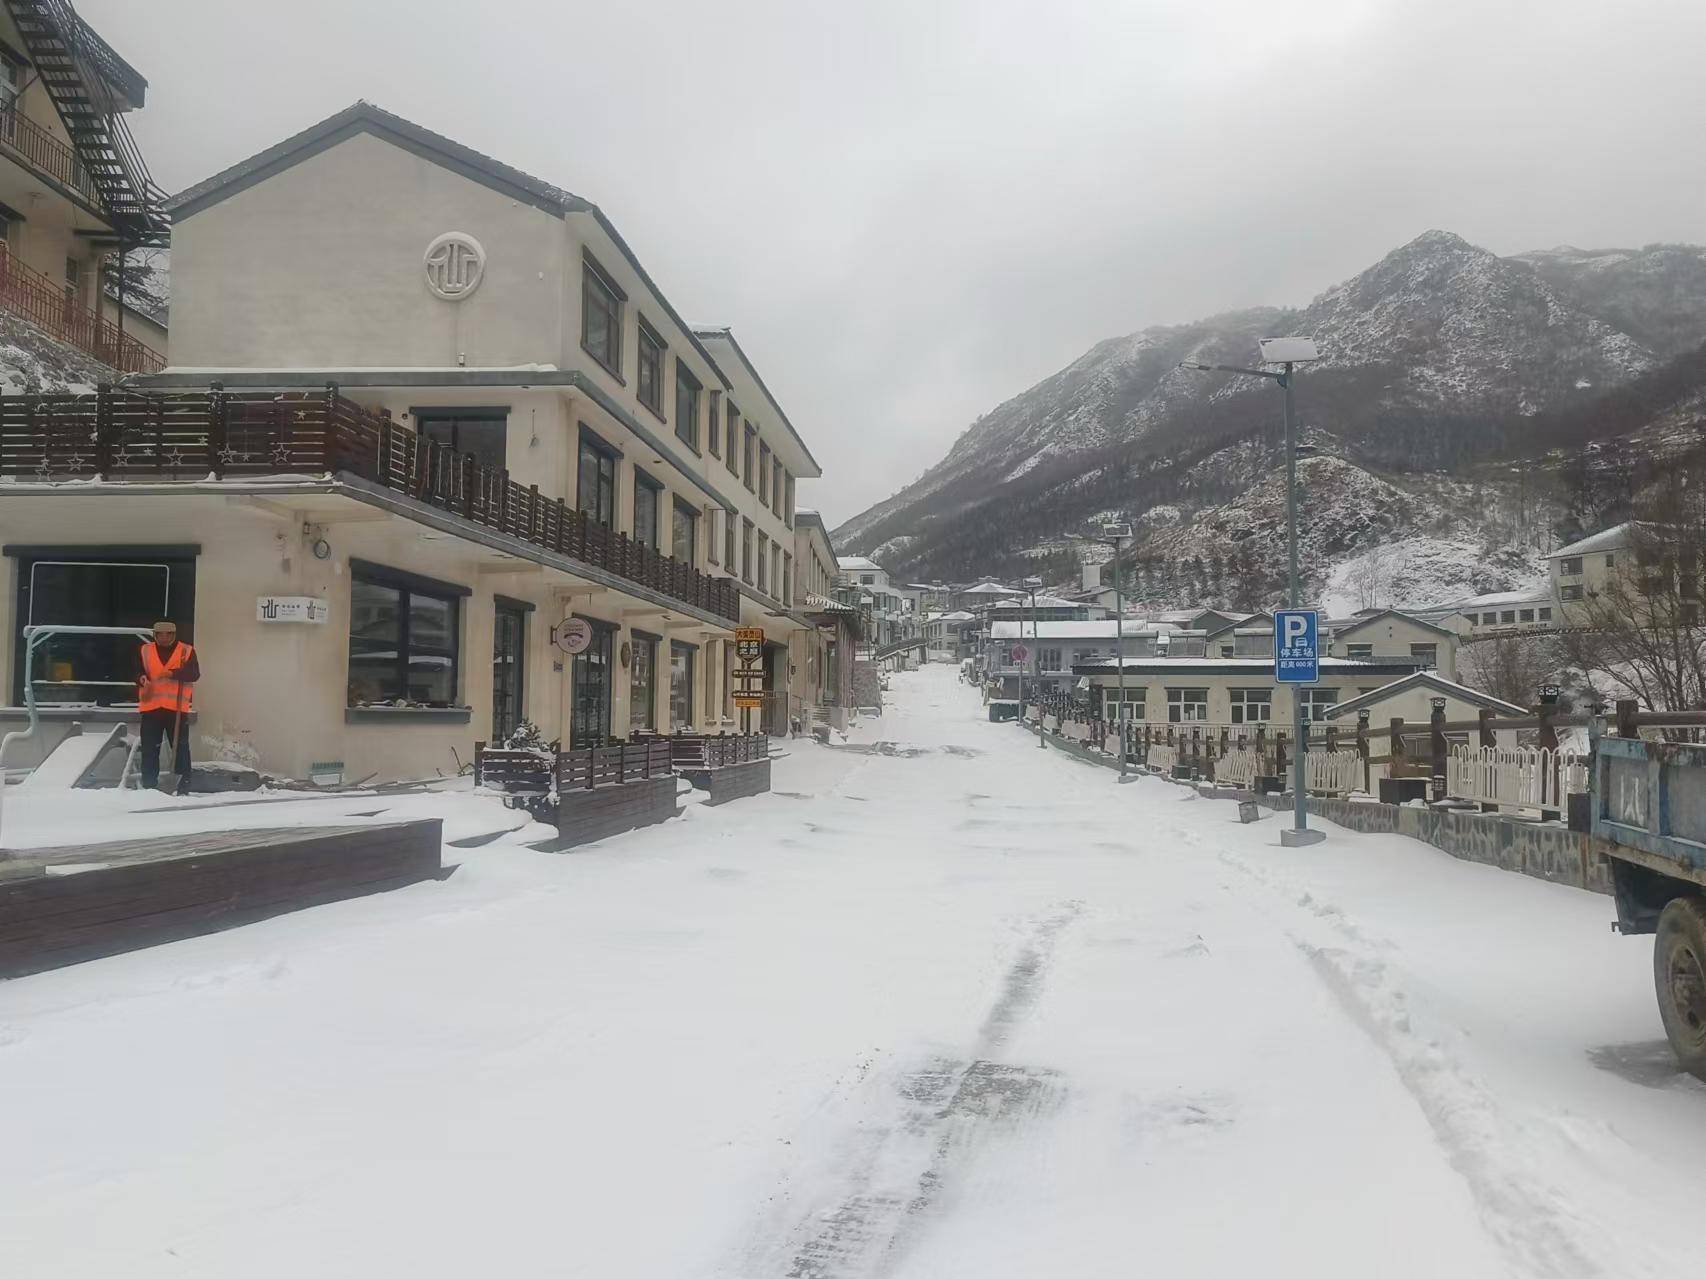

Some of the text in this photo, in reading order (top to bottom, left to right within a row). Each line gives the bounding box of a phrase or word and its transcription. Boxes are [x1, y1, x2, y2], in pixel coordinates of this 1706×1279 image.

[1285, 615, 1307, 648] P
[1281, 647, 1314, 657] 停车场
